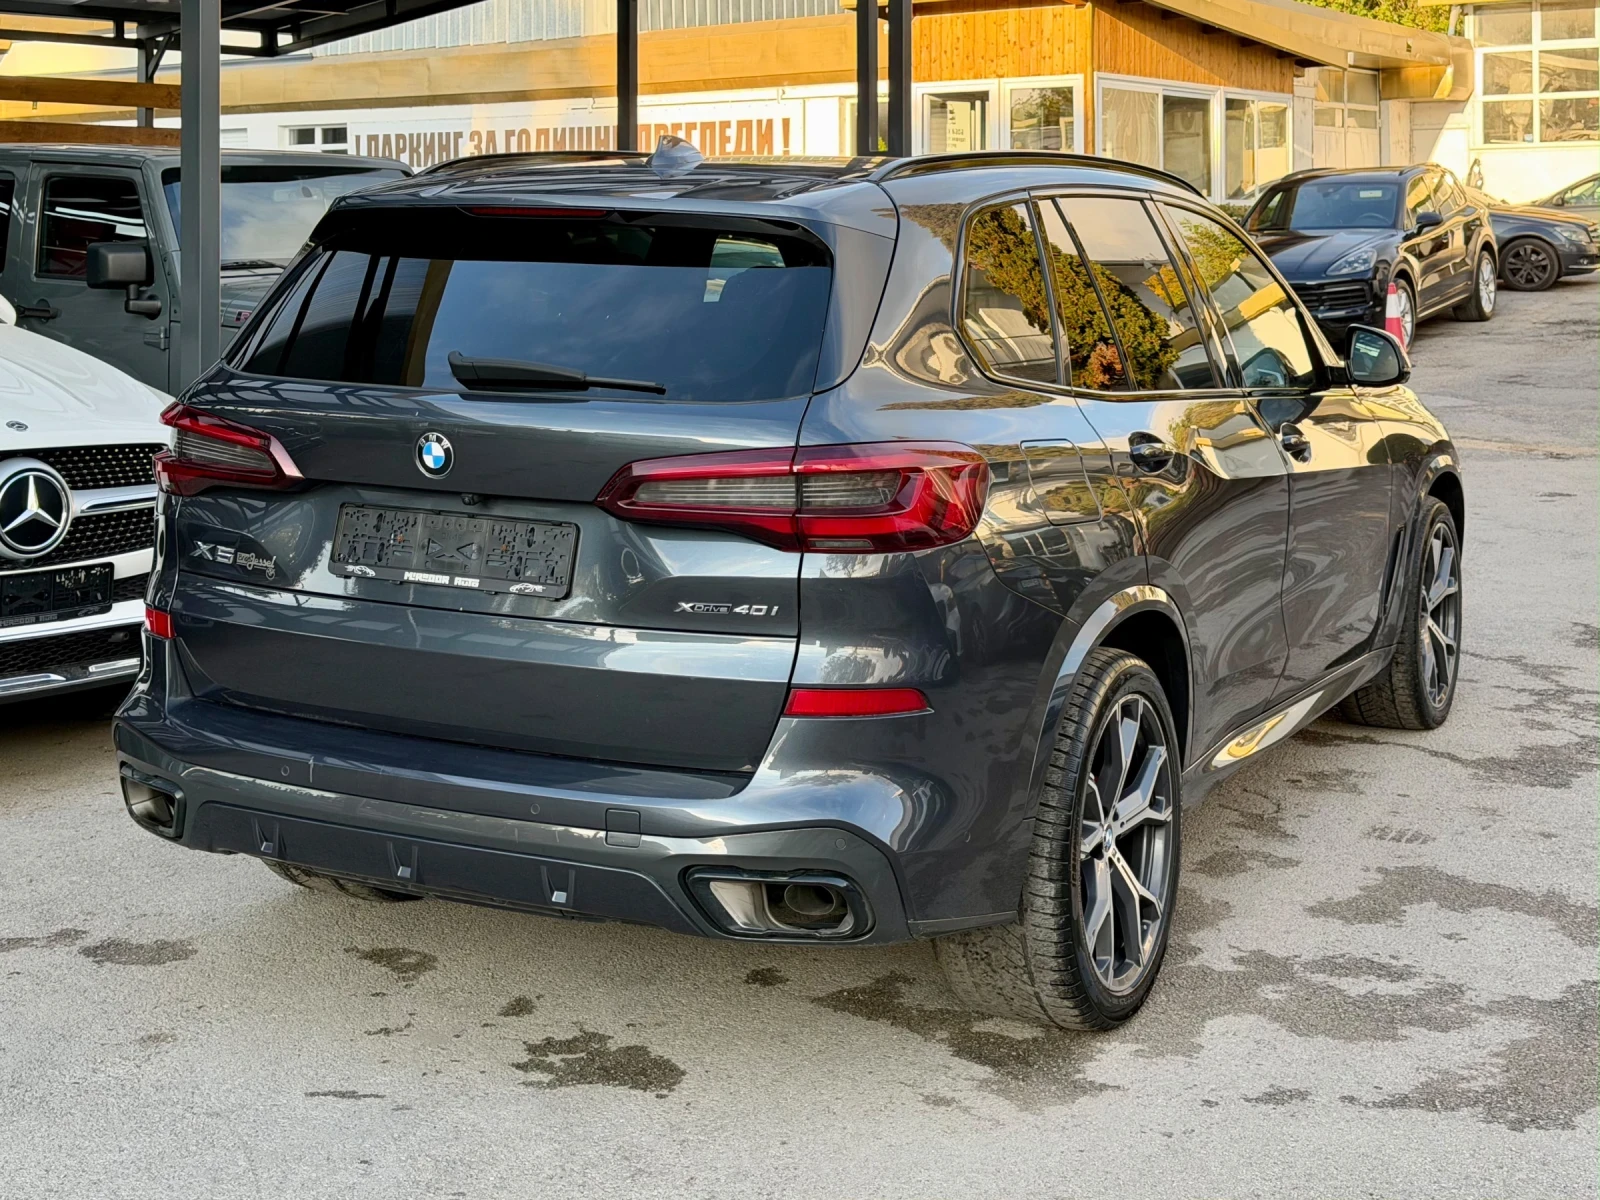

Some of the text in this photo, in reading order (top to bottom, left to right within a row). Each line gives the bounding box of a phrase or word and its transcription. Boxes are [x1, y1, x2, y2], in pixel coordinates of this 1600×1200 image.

[367, 131, 463, 168] ПАРКИНГ
[469, 130, 497, 156] ЗА
[189, 541, 236, 564] X5
